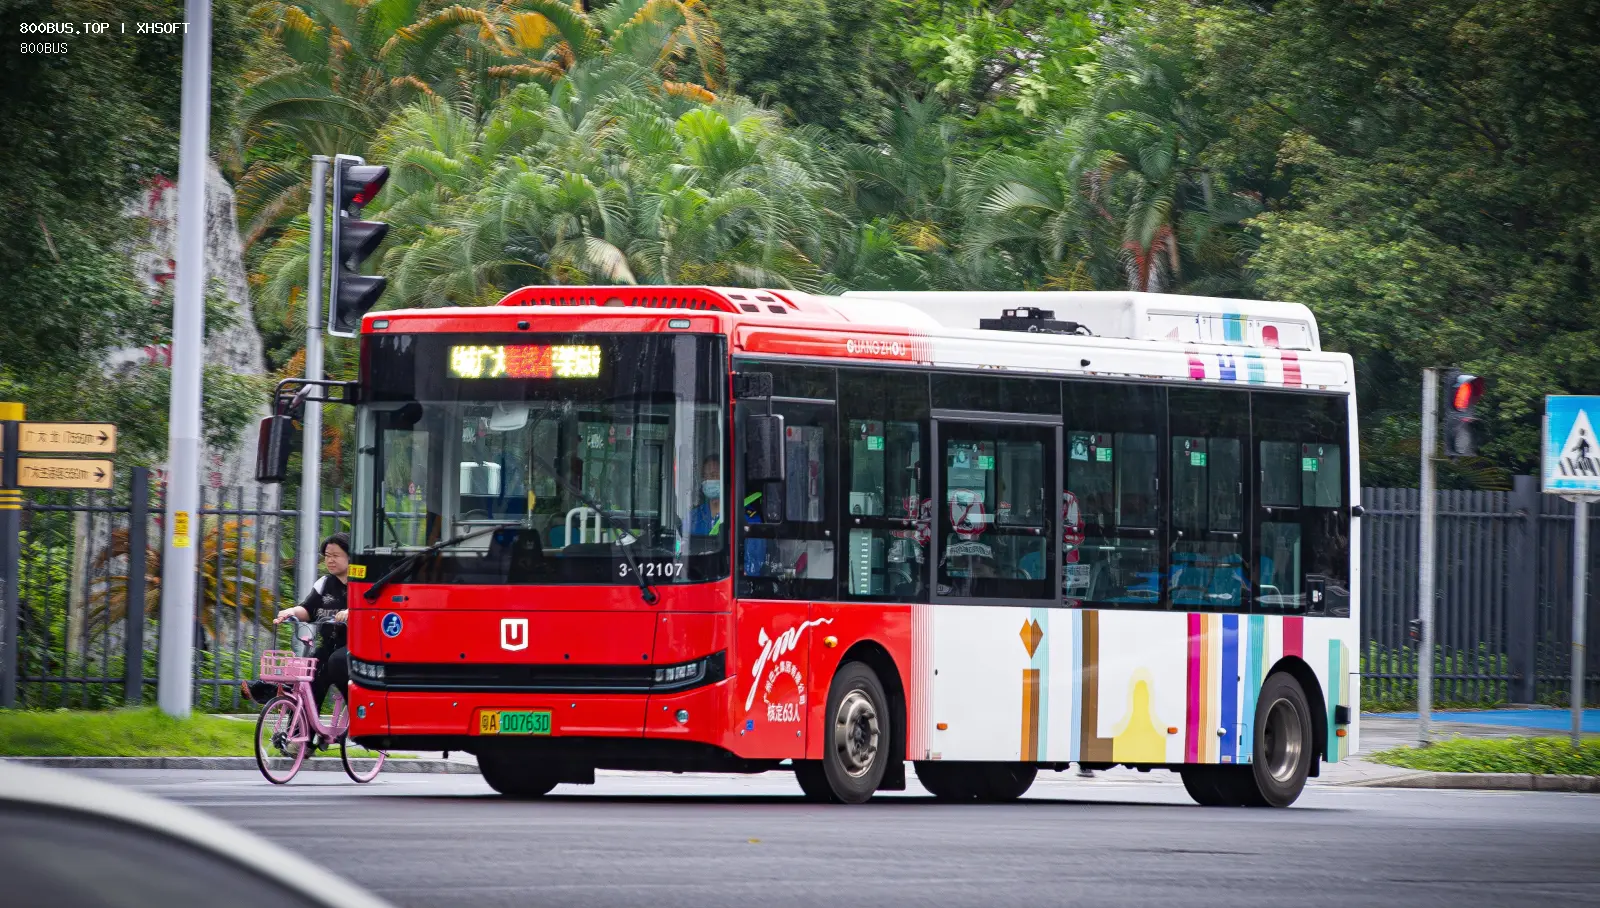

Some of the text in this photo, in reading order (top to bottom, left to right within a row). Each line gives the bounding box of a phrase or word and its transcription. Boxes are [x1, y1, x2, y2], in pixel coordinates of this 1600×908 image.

[846, 339, 906, 356] GUANGZHOU
[619, 562, 684, 577] 3-12107
[767, 702, 801, 722] 核定63人
